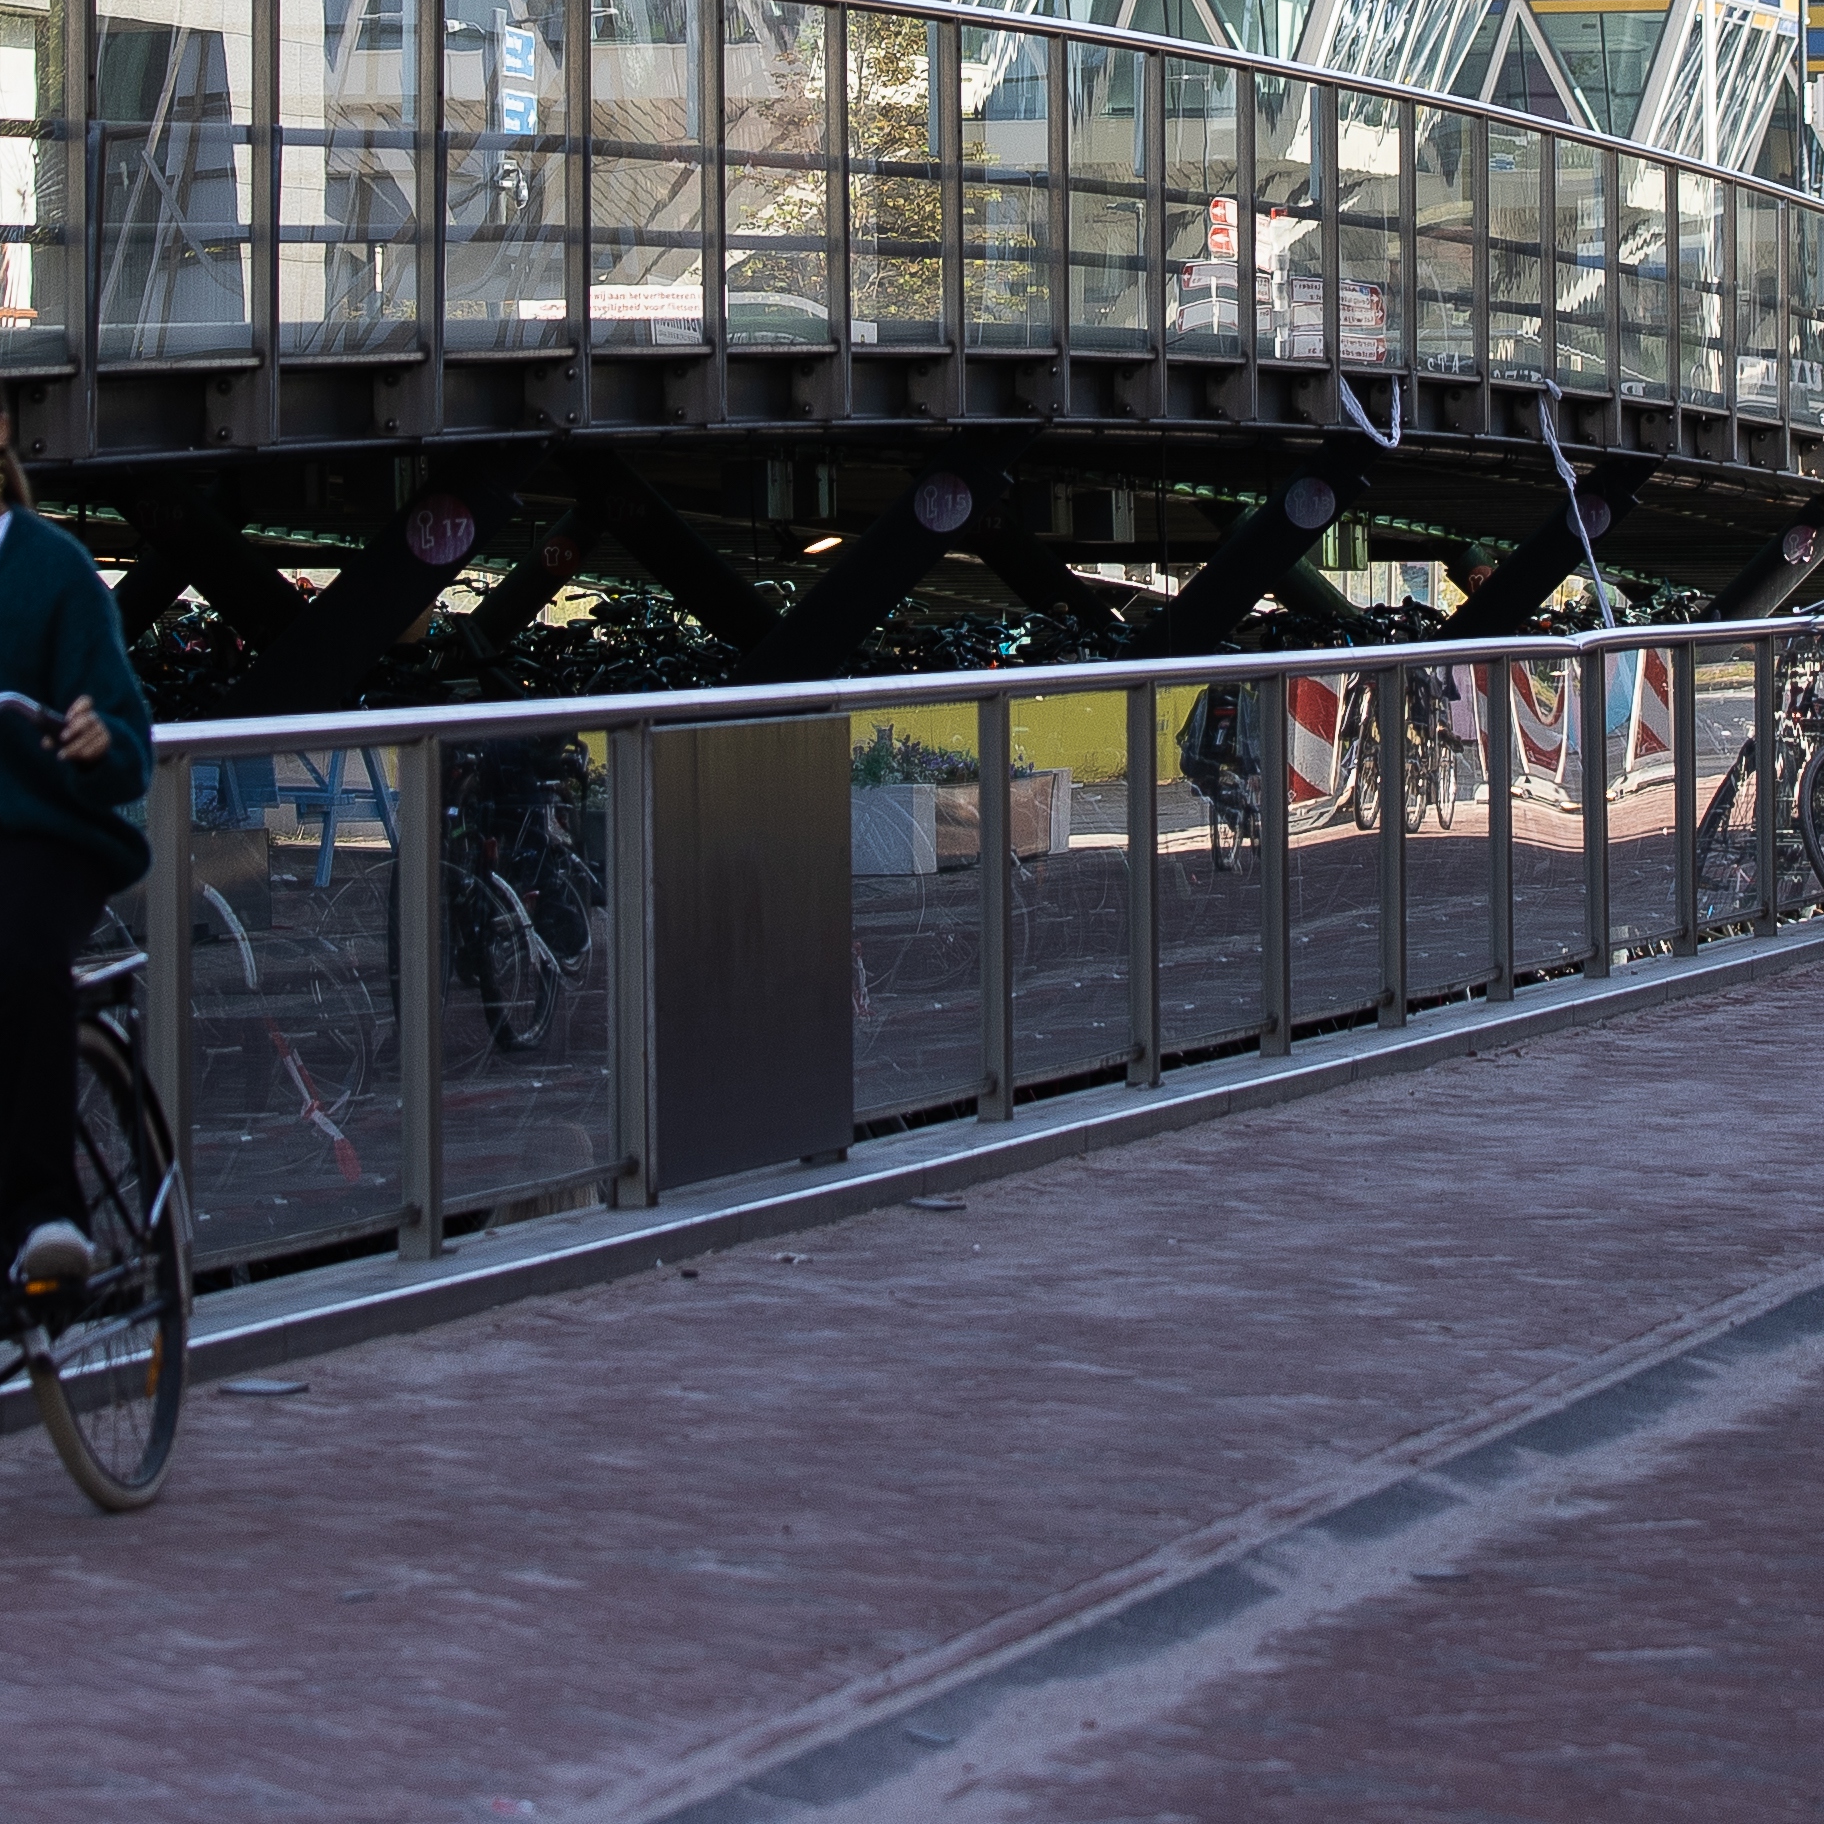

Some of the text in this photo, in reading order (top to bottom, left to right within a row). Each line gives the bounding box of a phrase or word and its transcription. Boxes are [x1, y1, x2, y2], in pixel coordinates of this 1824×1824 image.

[944, 493, 967, 511] 15
[443, 517, 468, 537] 17
[985, 516, 1002, 529] 12
